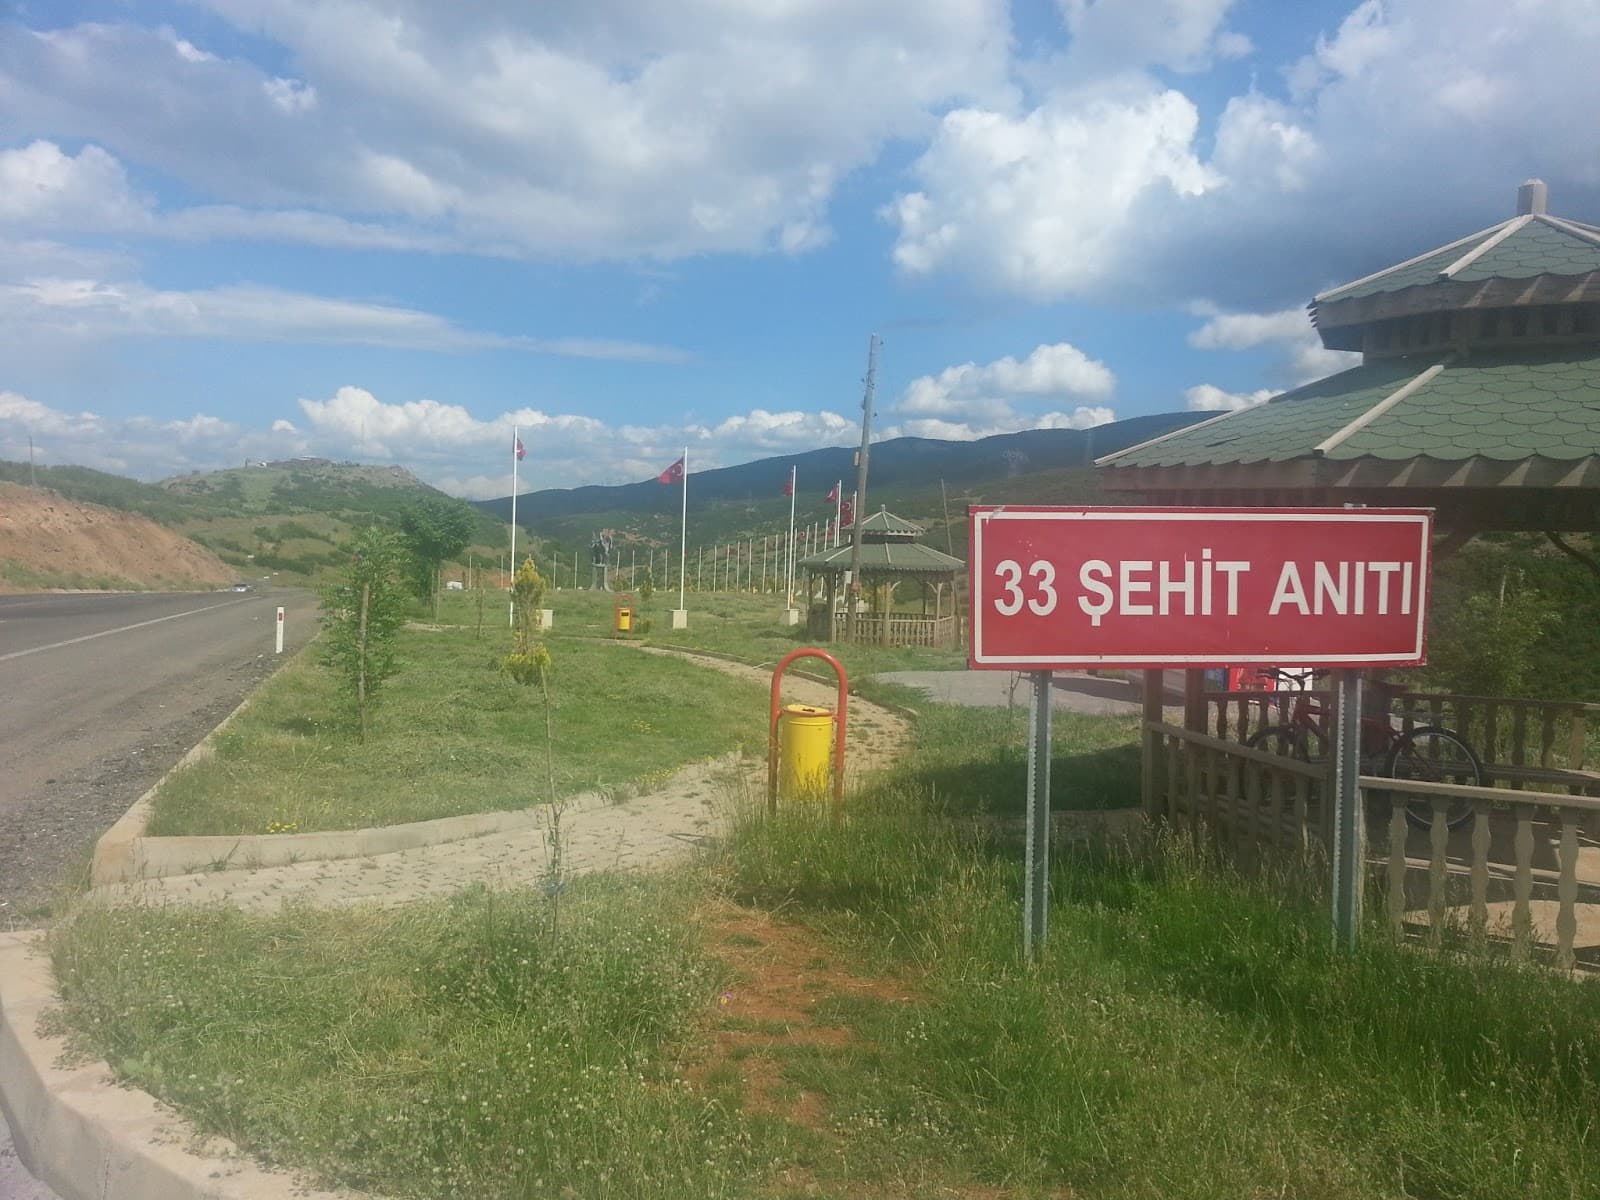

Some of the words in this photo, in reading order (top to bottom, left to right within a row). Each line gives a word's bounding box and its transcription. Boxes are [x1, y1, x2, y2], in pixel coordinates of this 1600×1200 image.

[994, 559, 1058, 617] 33
[1077, 548, 1251, 627] ŞEHİT
[1268, 560, 1414, 616] ANITI
